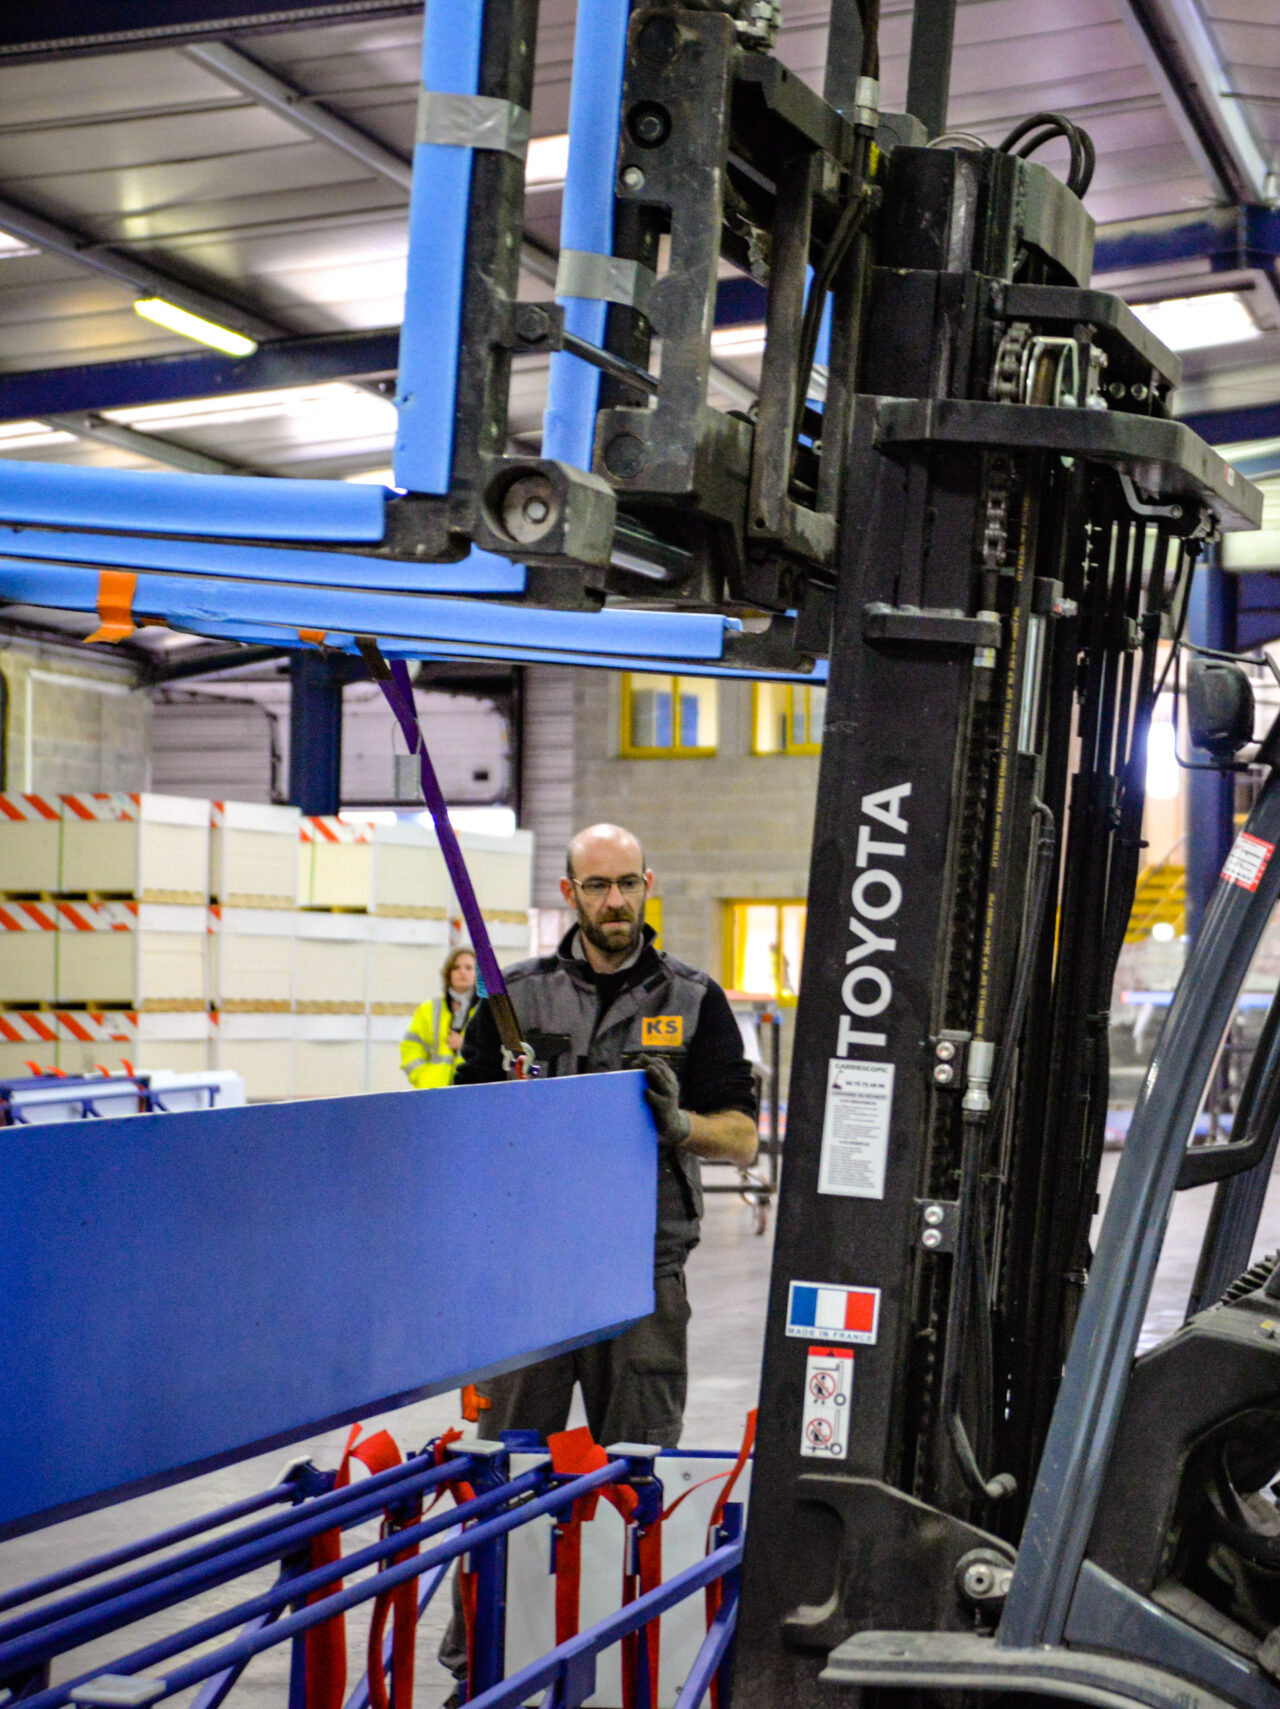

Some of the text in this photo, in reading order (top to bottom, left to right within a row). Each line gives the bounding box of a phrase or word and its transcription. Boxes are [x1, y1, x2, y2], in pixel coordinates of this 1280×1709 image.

[836, 782, 912, 1057] TOYOTA
[646, 1020, 679, 1035] KS
[787, 1327, 873, 1342] MADE IN FRANCE
